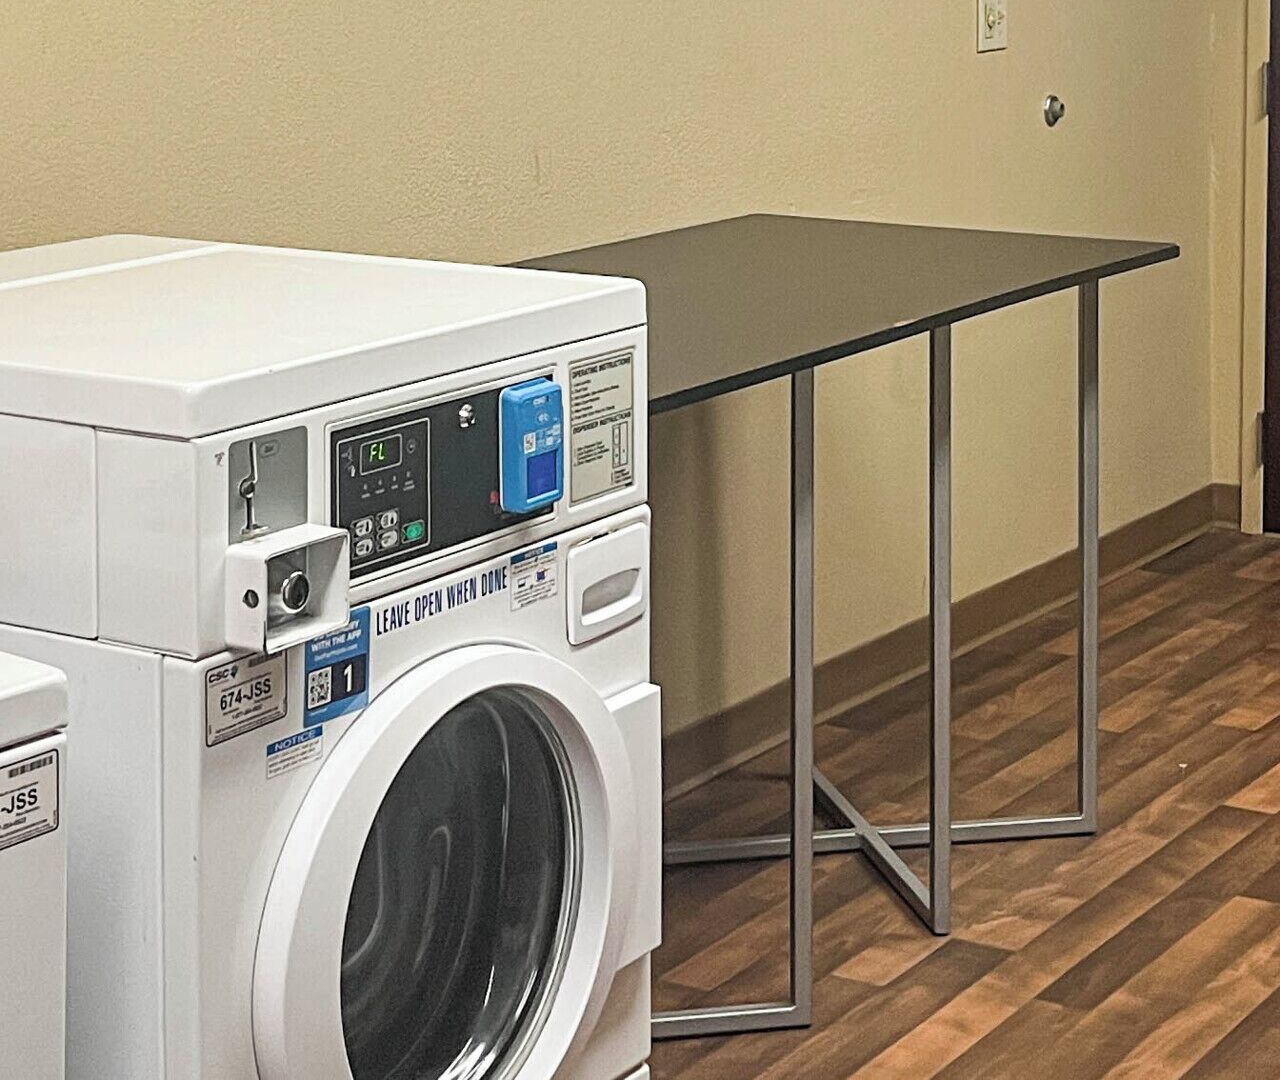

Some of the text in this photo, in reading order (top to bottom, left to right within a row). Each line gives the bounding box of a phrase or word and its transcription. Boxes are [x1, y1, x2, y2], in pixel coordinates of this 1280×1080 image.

[376, 601, 410, 636] LEAVE
[414, 588, 443, 621] OPEN
[446, 576, 477, 609] WHEN
[481, 566, 508, 597] DONE
[312, 639, 331, 652] WITH
[332, 634, 345, 646] THE
[347, 629, 361, 641] APP
[209, 669, 230, 683] CSC
[343, 663, 353, 693] 1
[220, 678, 272, 711] 674-JSS
[274, 730, 316, 751] NOTICE
